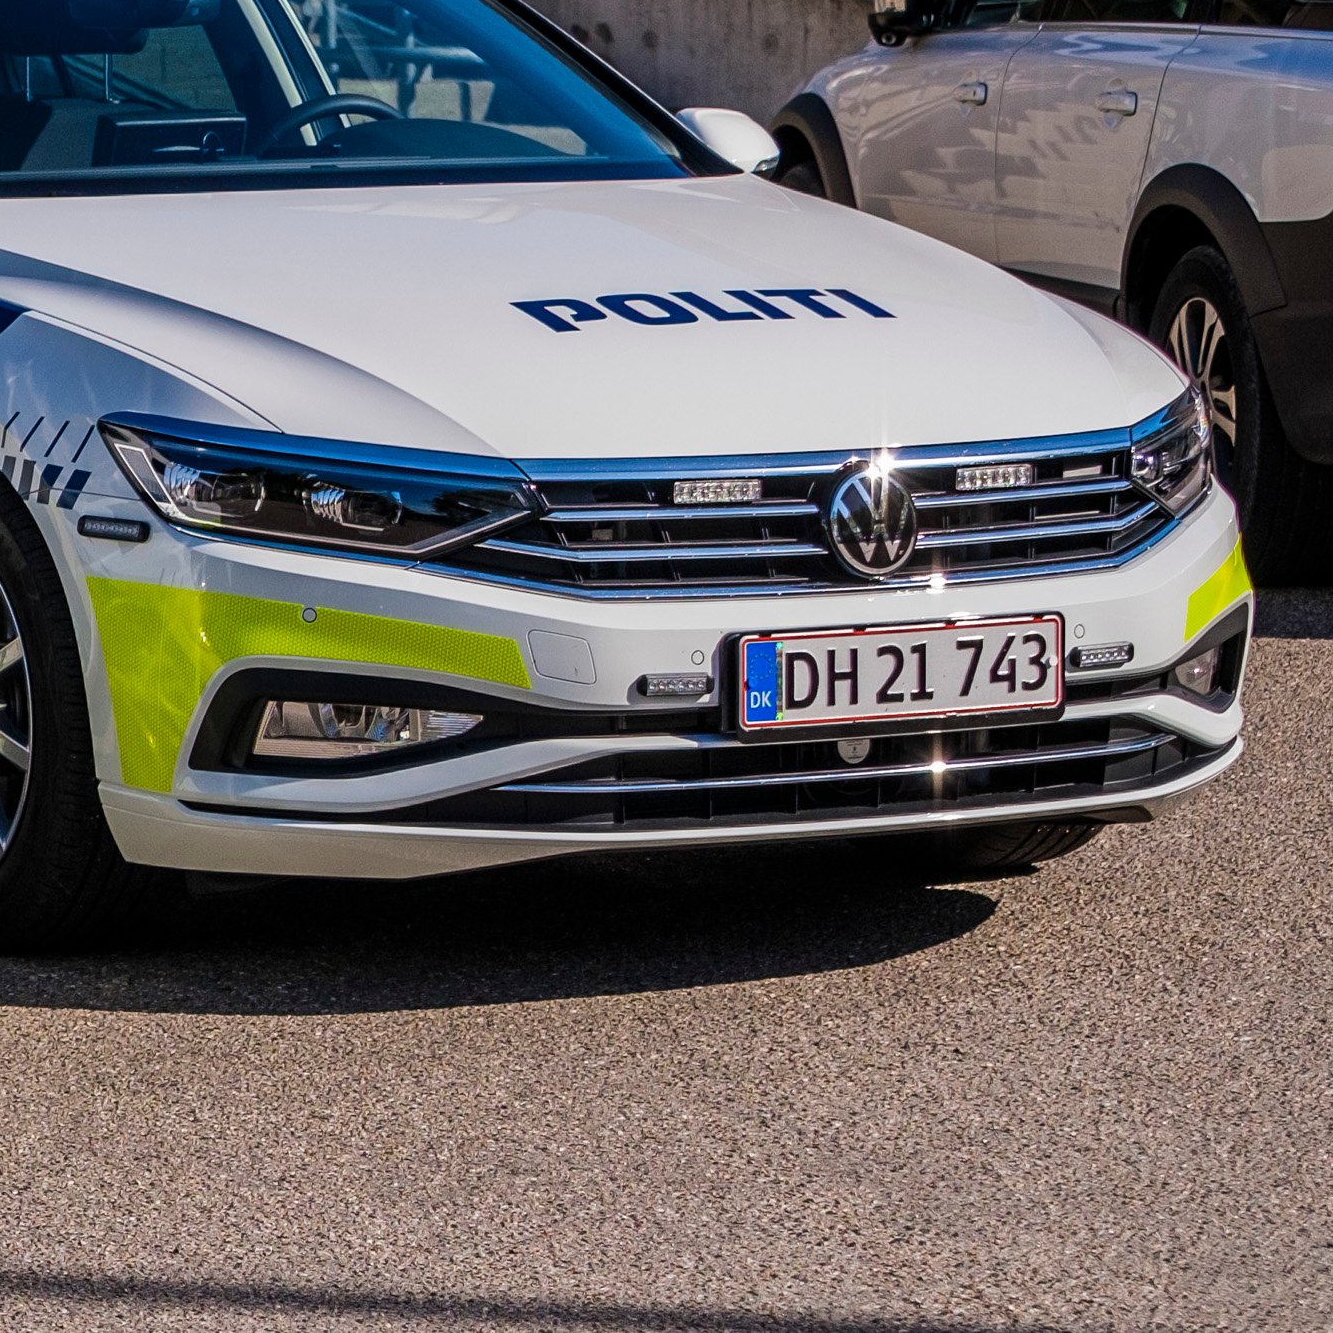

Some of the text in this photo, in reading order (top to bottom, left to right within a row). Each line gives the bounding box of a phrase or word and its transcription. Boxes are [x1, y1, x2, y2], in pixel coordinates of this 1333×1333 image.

[508, 288, 898, 333] POLITI
[785, 631, 1048, 710] DH 21 743
[749, 690, 772, 709] DK
